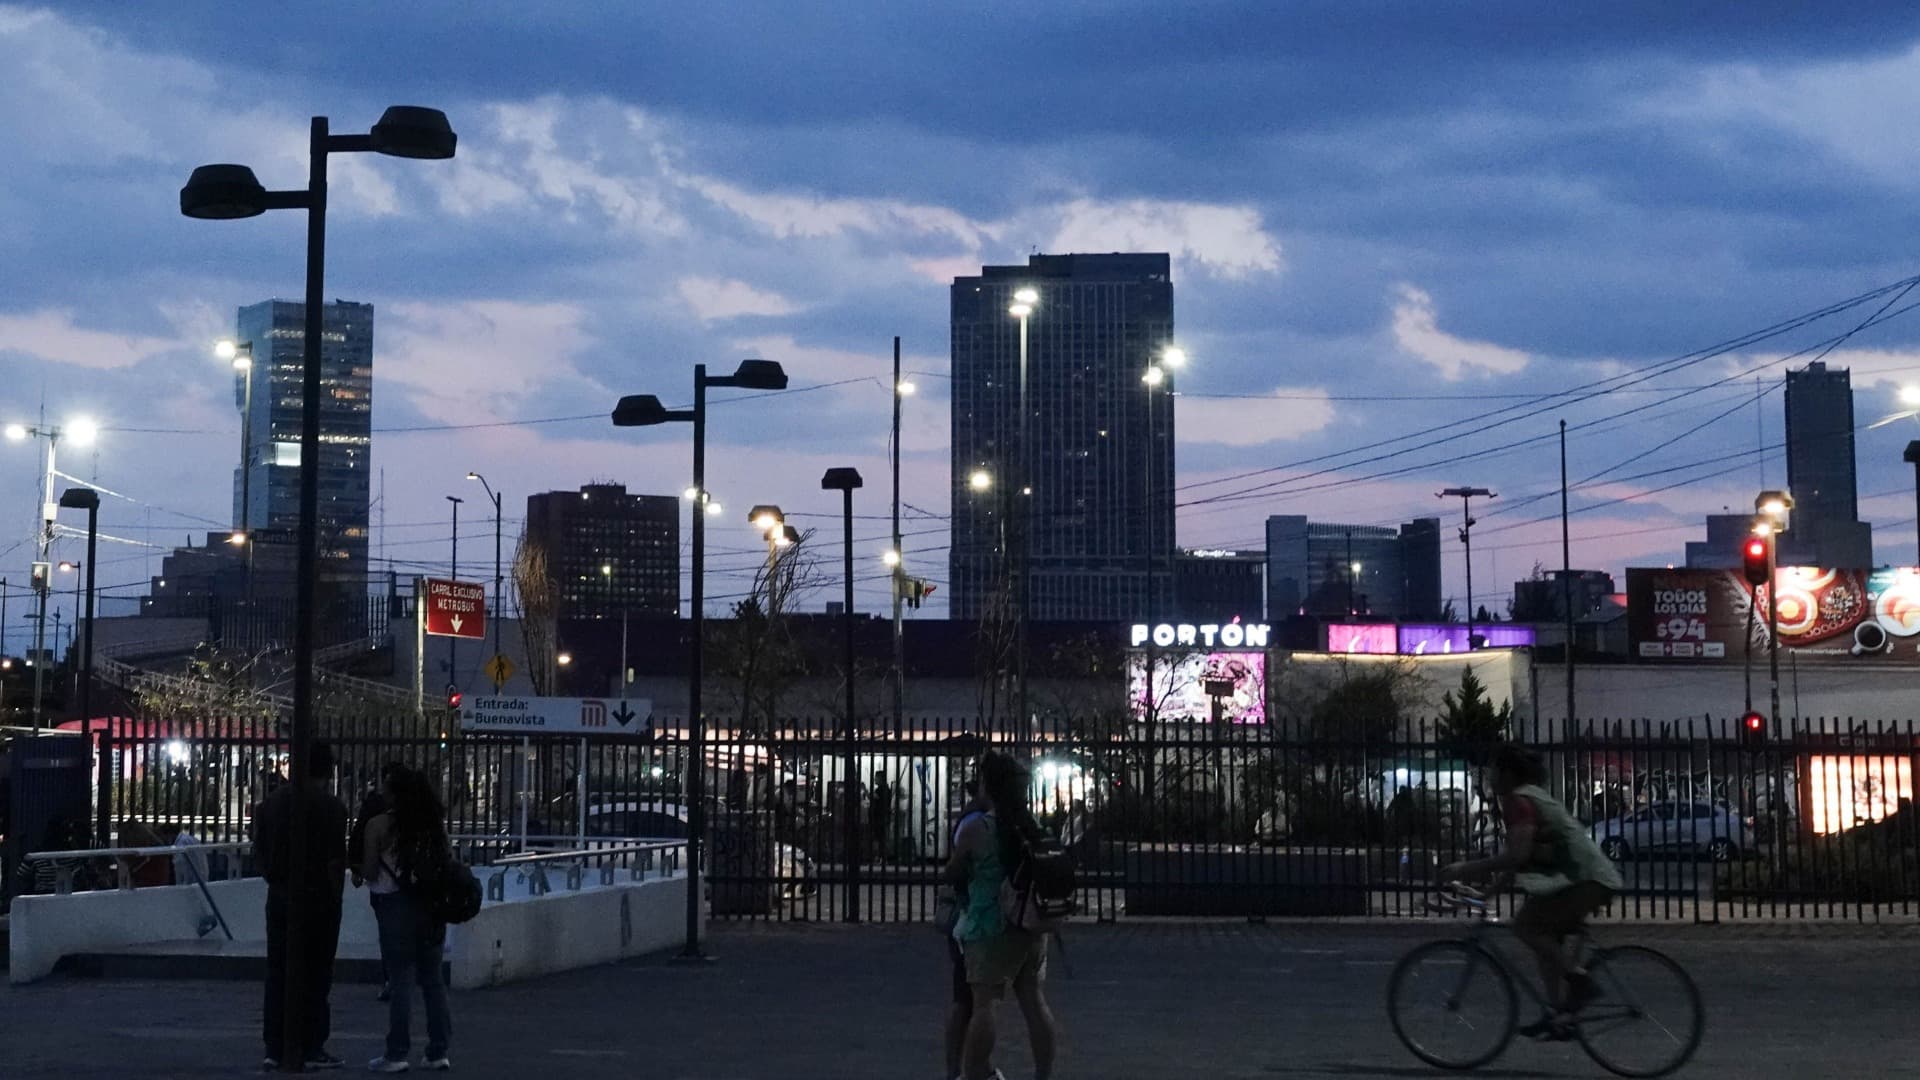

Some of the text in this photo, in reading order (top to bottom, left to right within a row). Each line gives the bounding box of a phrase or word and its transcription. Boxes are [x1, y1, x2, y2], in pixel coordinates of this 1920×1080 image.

[431, 583, 483, 601] CARRIL EXCLUSIVO
[437, 598, 475, 612] METROBUS
[1653, 603, 1677, 615] LOS
[1131, 615, 1267, 647] PORTÓN
[1656, 618, 1706, 641] $94
[475, 698, 529, 710] Entrada:
[475, 712, 545, 725] Buenavista
